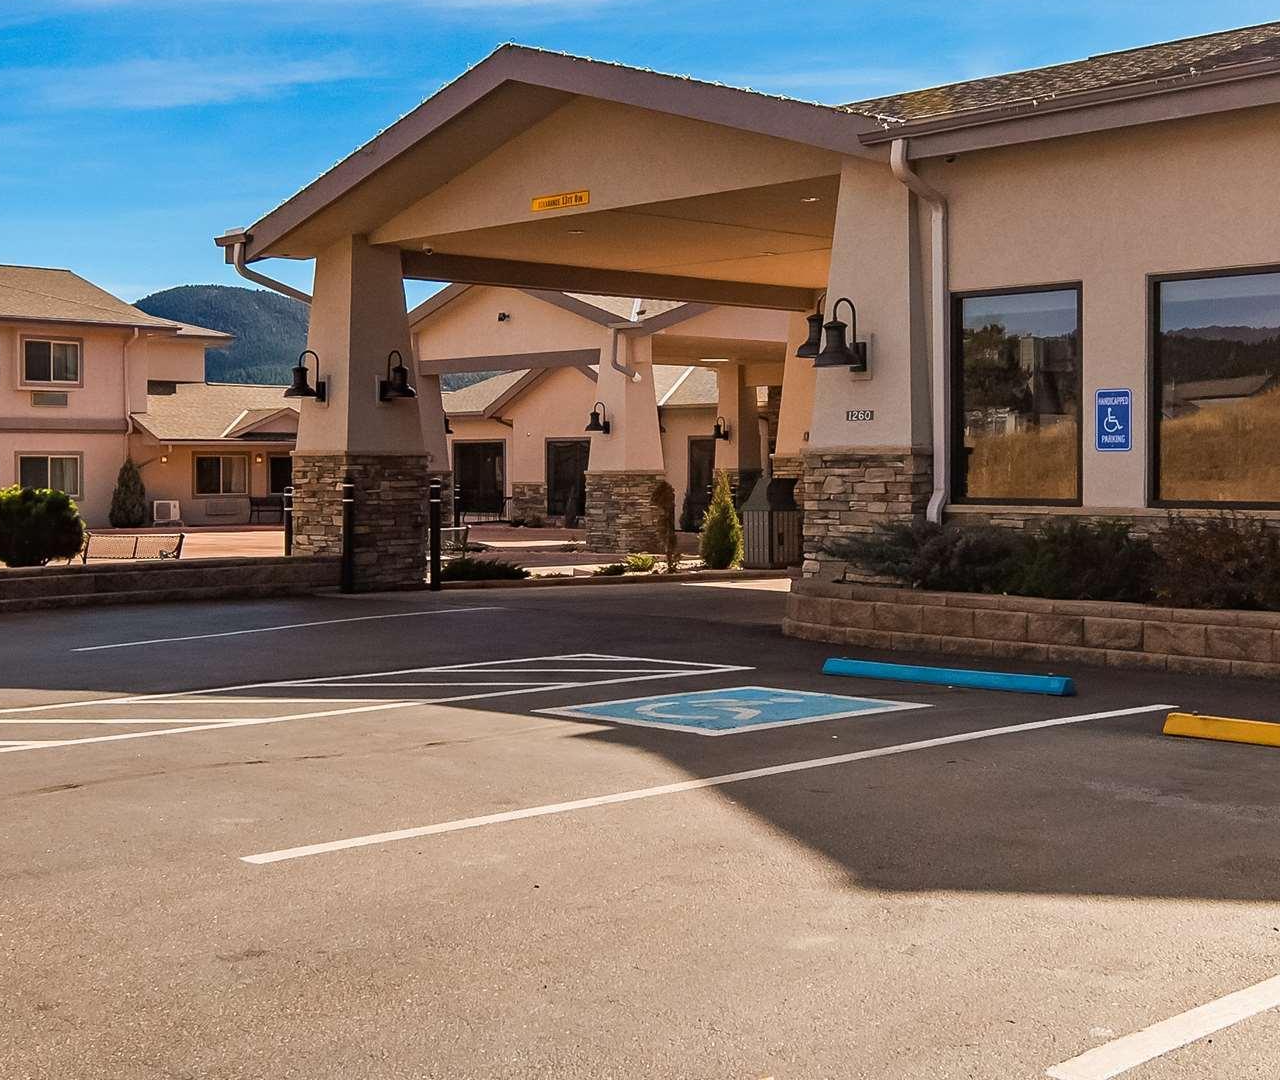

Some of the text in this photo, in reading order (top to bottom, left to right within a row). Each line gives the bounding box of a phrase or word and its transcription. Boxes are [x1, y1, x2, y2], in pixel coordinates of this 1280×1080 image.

[1098, 397, 1129, 406] HANDICAPPED
[848, 410, 871, 421] 1260
[1101, 435, 1126, 443] PARKING
